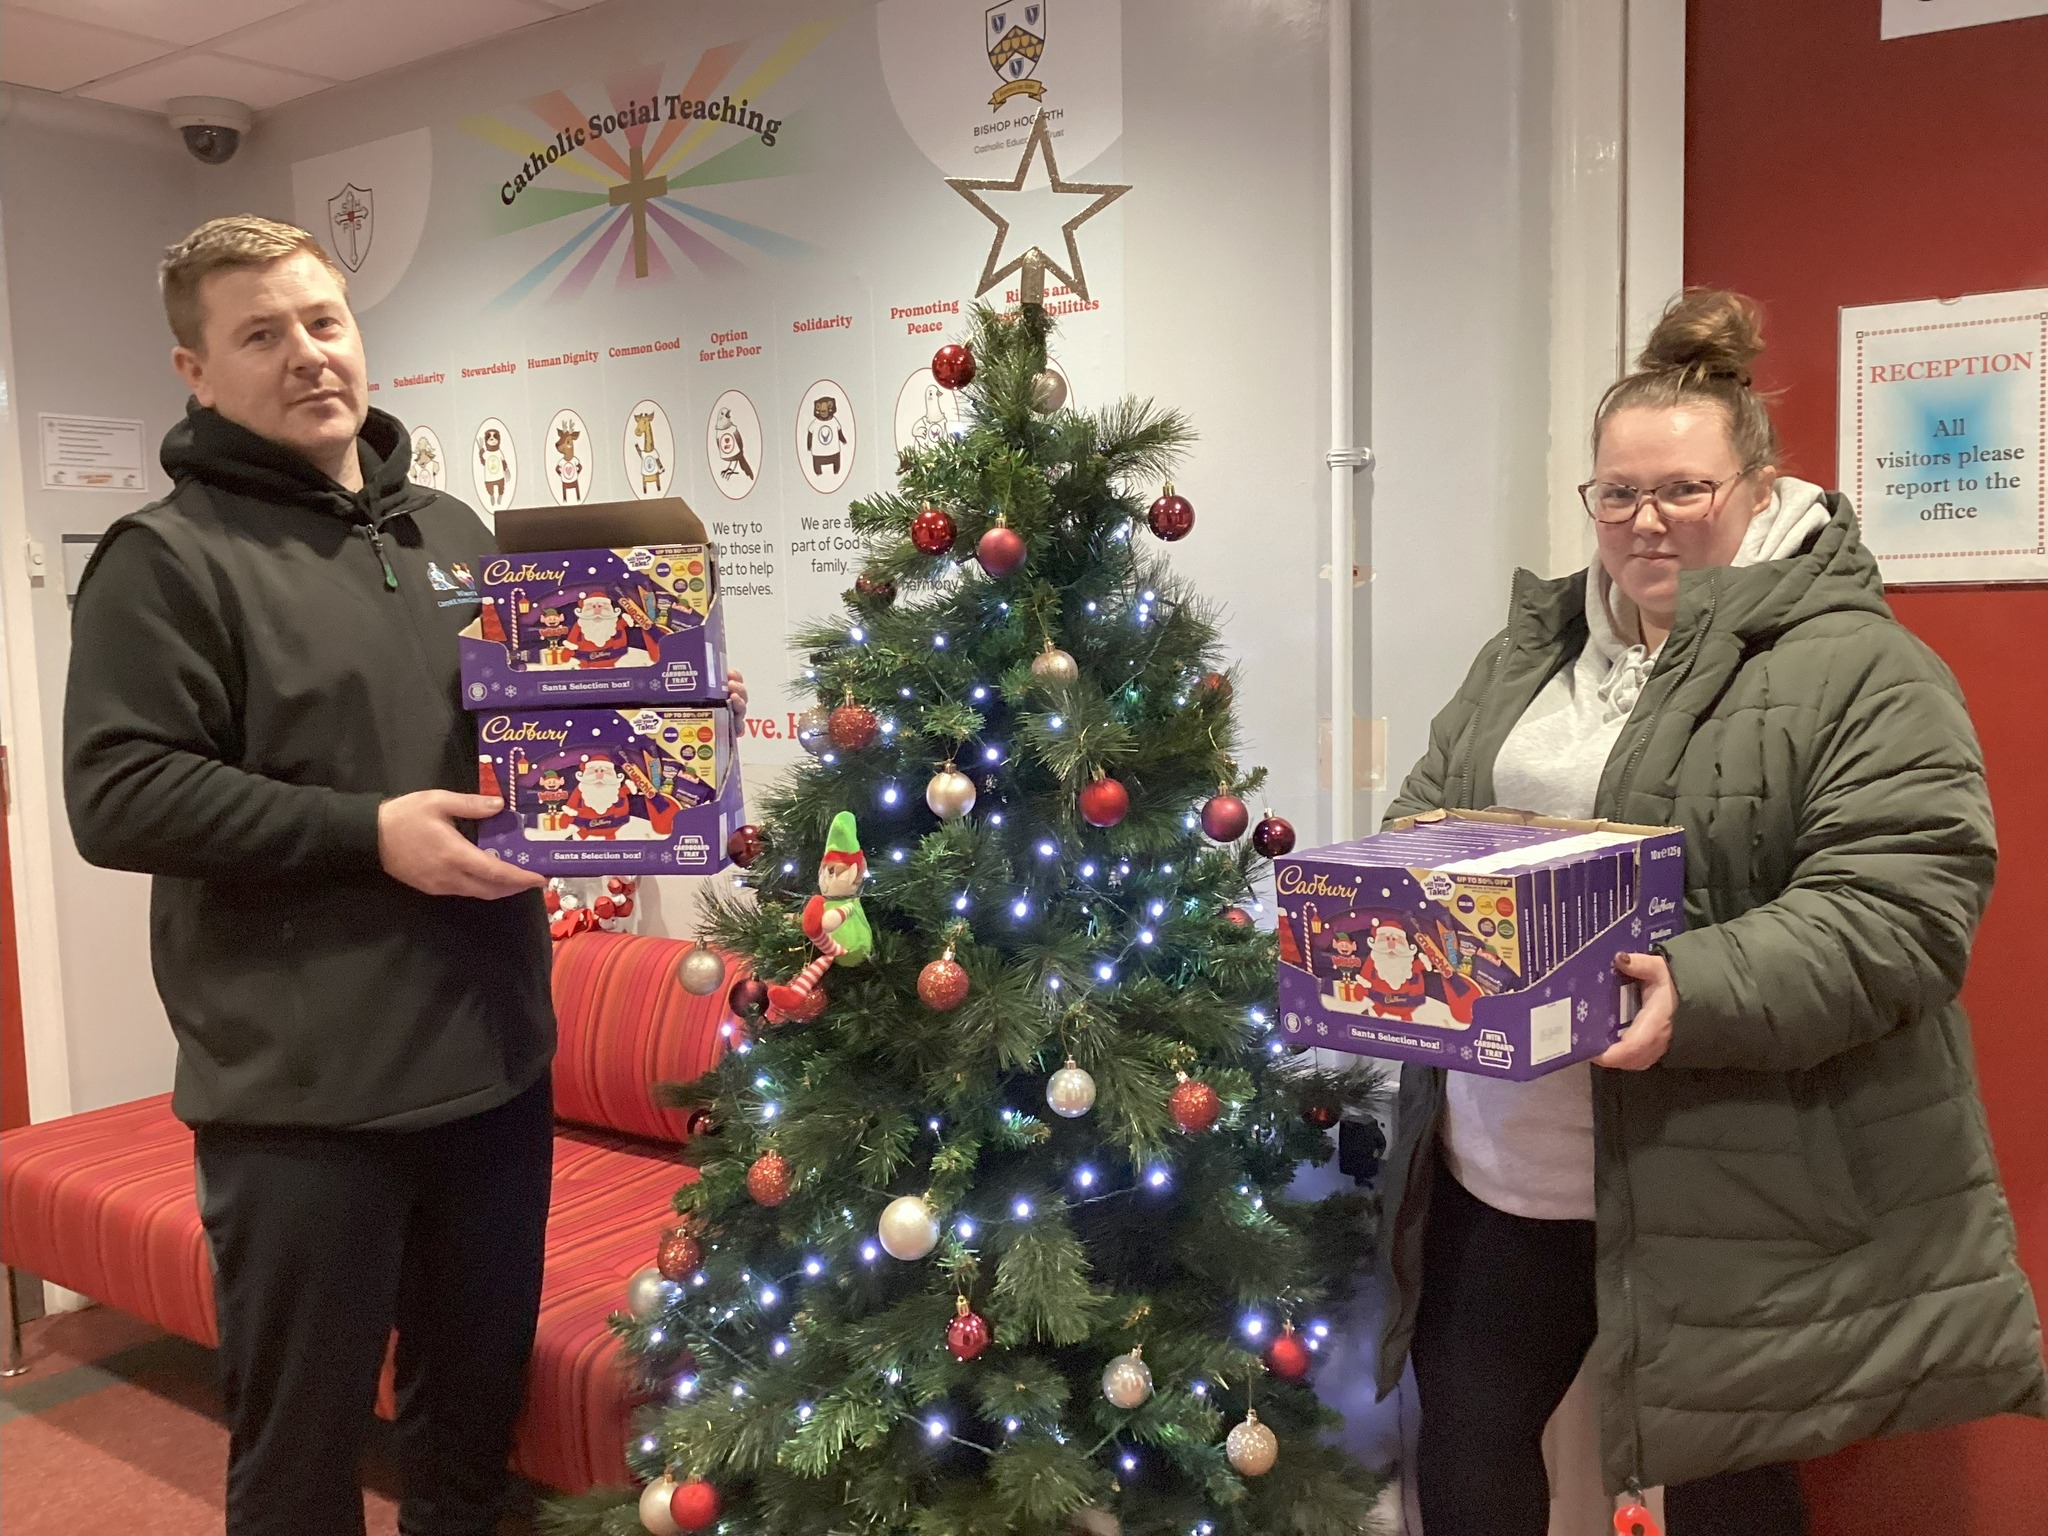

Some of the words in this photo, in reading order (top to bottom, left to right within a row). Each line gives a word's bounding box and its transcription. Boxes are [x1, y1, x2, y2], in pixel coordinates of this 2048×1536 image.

[974, 120, 1011, 137] BISHOP
[1014, 109, 1064, 127] HOGRTH
[501, 127, 586, 205] Catholic
[589, 97, 661, 140] Social
[664, 95, 783, 147] Teaching
[974, 141, 1004, 154] Catholic
[1006, 288, 1050, 303] Ris
[1052, 285, 1073, 297] an
[890, 299, 960, 320] Promoting
[793, 314, 853, 333] Solidarity
[907, 320, 943, 335] Peace
[711, 329, 748, 346] Option
[608, 343, 653, 358] Common
[654, 337, 680, 352] Good
[700, 350, 715, 362] for
[717, 347, 734, 360] the
[736, 345, 762, 358] Poor
[527, 356, 562, 369] Human
[562, 350, 599, 365] Dignity
[1869, 351, 2034, 384] RECEPTION
[461, 361, 516, 378] Stewardship
[394, 372, 445, 388] Subsidiarity
[1932, 418, 1965, 438] All
[1876, 450, 1951, 469] visitors
[1958, 445, 2025, 469] please
[1886, 478, 1951, 499] report
[1957, 476, 1978, 491] to
[1986, 471, 2021, 490] the
[1920, 502, 1978, 521] office
[712, 522, 730, 535] We
[732, 522, 748, 537] try
[751, 521, 763, 533] to
[801, 517, 819, 530] We
[822, 518, 841, 529] are
[717, 543, 728, 558] lp
[730, 542, 761, 555] those
[763, 540, 774, 554] in
[791, 538, 816, 555] part
[818, 536, 831, 551] of
[484, 559, 565, 587] Cadbury
[719, 563, 733, 576] ed
[736, 563, 748, 575] to
[750, 562, 774, 578] help
[811, 558, 849, 575] family.
[720, 582, 773, 596] emselves.
[542, 683, 567, 691] Santa
[569, 681, 609, 690] Selection
[611, 680, 630, 688] box!
[482, 715, 568, 747] Cadbury
[741, 718, 782, 739] ve.
[554, 852, 579, 860] Santa
[581, 851, 620, 860] Selection
[623, 851, 642, 859] box!
[1277, 864, 1358, 907] Cadbury
[1351, 1028, 1376, 1040] Santa
[1378, 1032, 1418, 1047] Selection
[1420, 1039, 1440, 1050] box!
